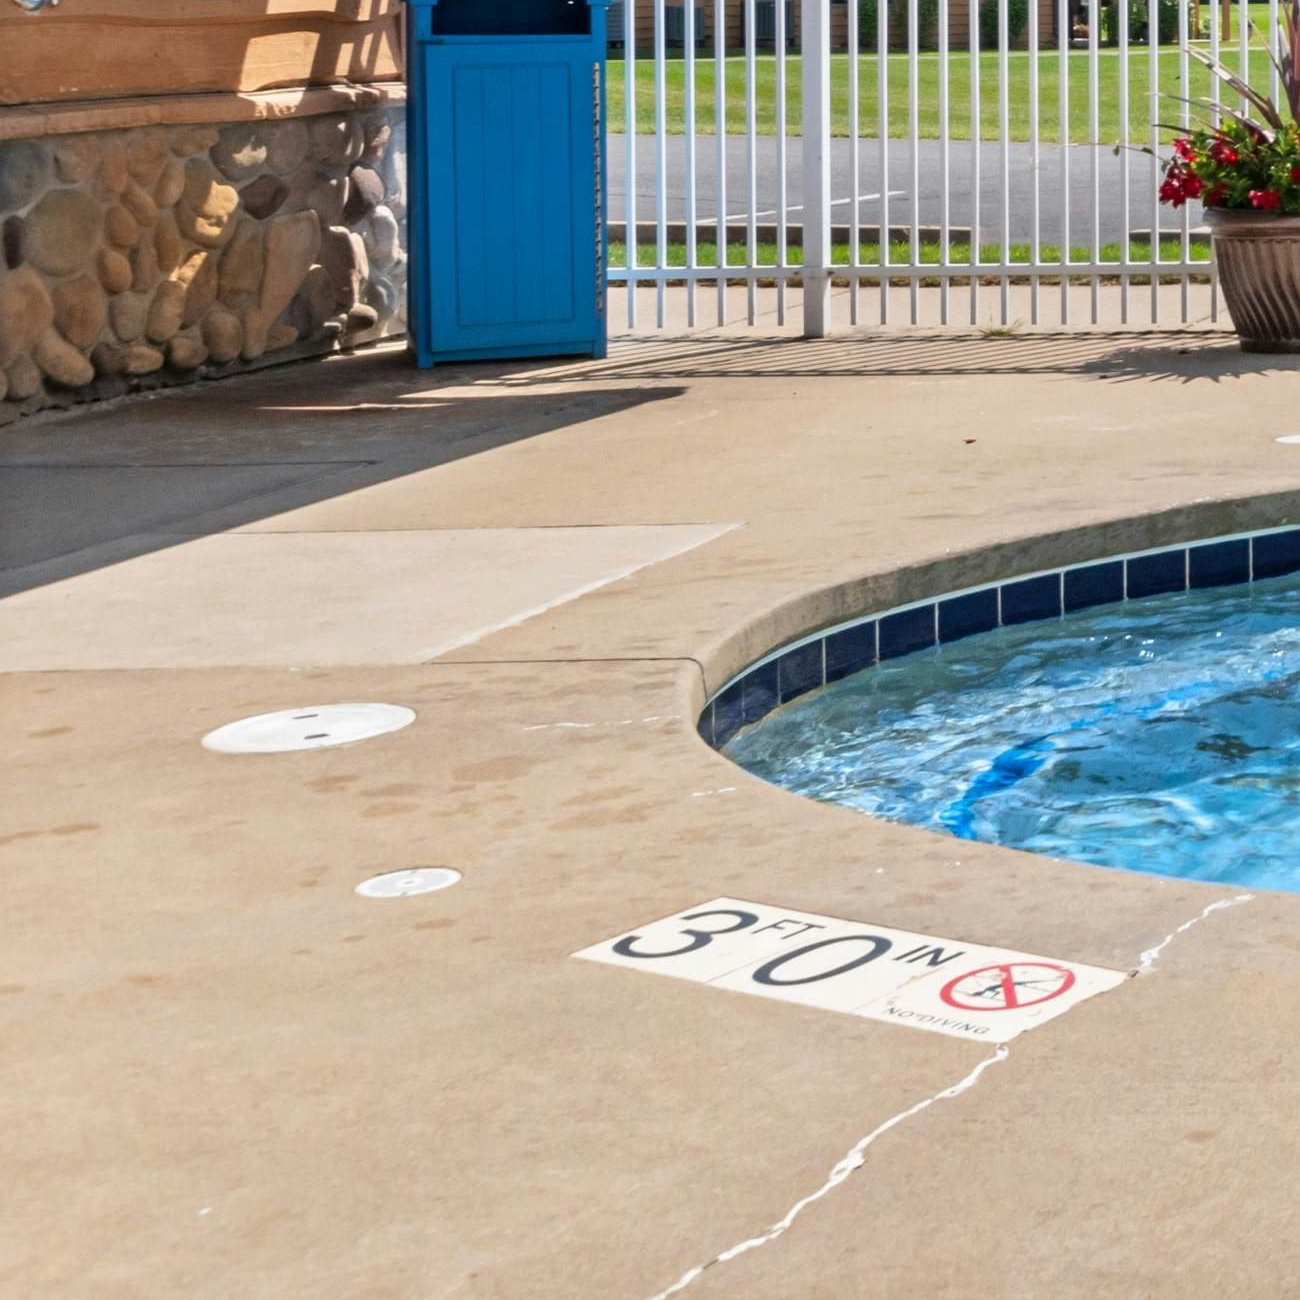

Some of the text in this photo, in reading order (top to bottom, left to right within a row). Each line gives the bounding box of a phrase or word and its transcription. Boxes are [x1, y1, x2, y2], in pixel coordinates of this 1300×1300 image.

[612, 909, 966, 987] 3 FT 0 IN
[916, 1014, 991, 1034] DIVING
